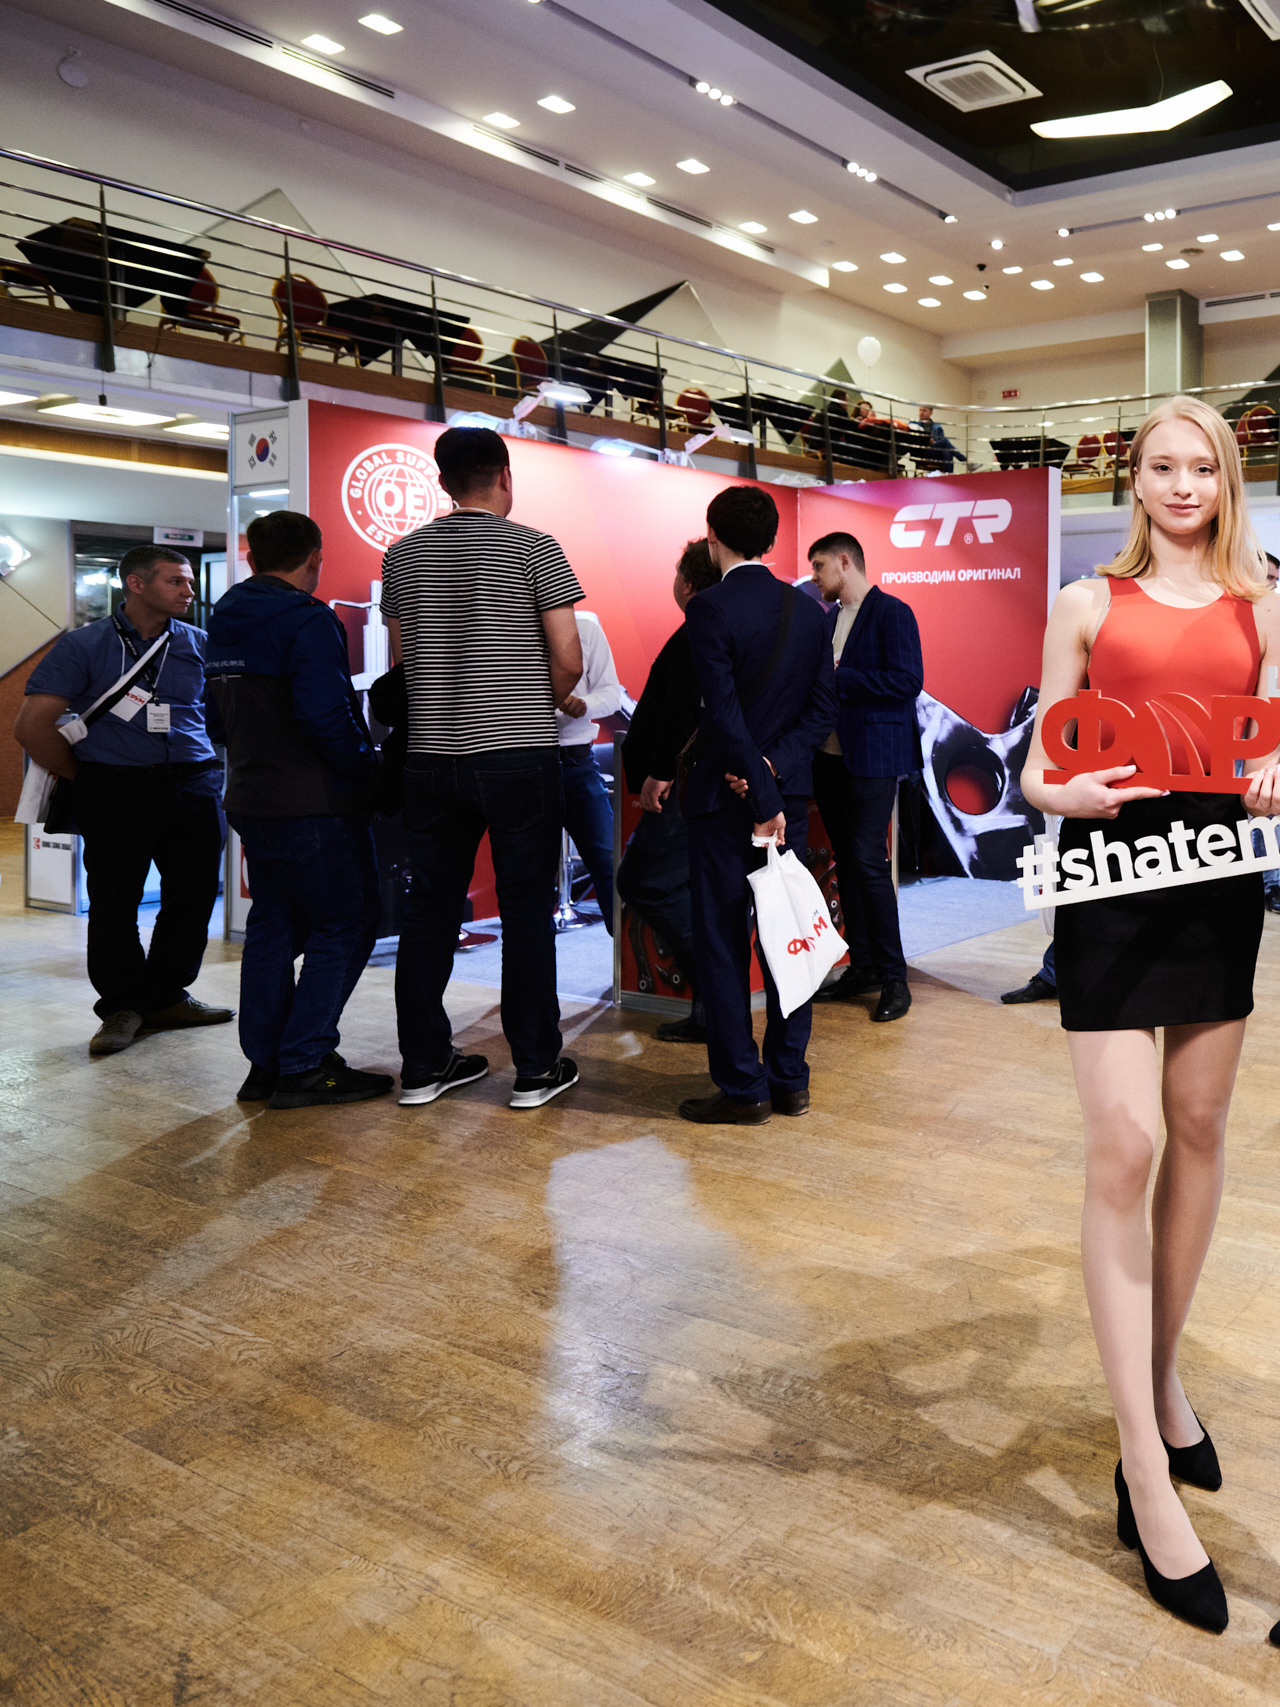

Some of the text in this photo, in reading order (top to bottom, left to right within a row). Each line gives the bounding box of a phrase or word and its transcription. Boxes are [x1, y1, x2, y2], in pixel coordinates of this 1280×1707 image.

[350, 452, 392, 498] GLOBAL
[376, 482, 426, 517] OE
[890, 498, 1012, 548] CTR
[882, 568, 1021, 585] ПРОИЗВОДИМ ОРИГИНАЛ
